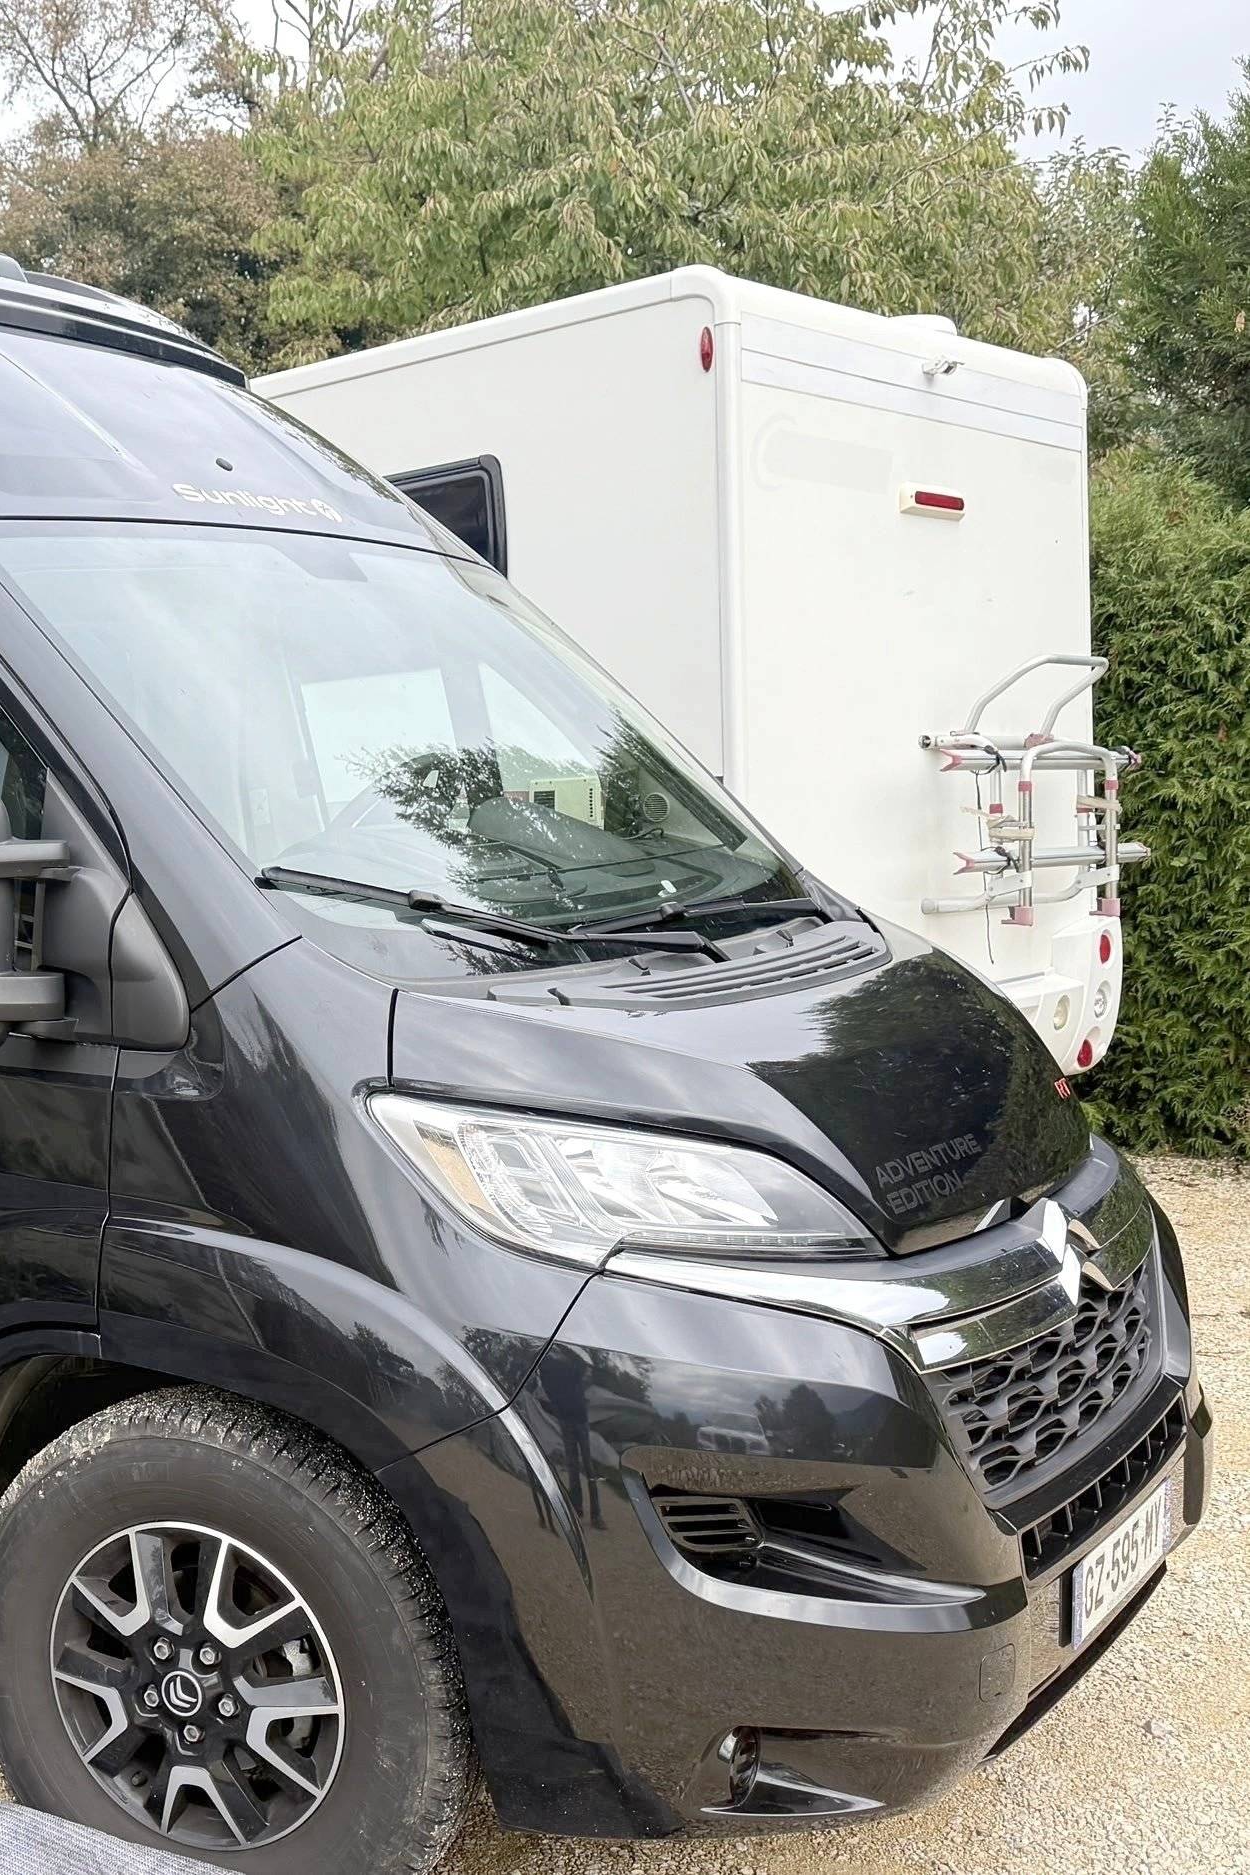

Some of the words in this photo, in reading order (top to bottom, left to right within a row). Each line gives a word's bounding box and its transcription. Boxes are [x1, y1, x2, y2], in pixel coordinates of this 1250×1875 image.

[171, 483, 317, 516] Sunlight
[875, 1133, 982, 1188] ADVENTURE
[886, 1169, 963, 1215] EDITION
